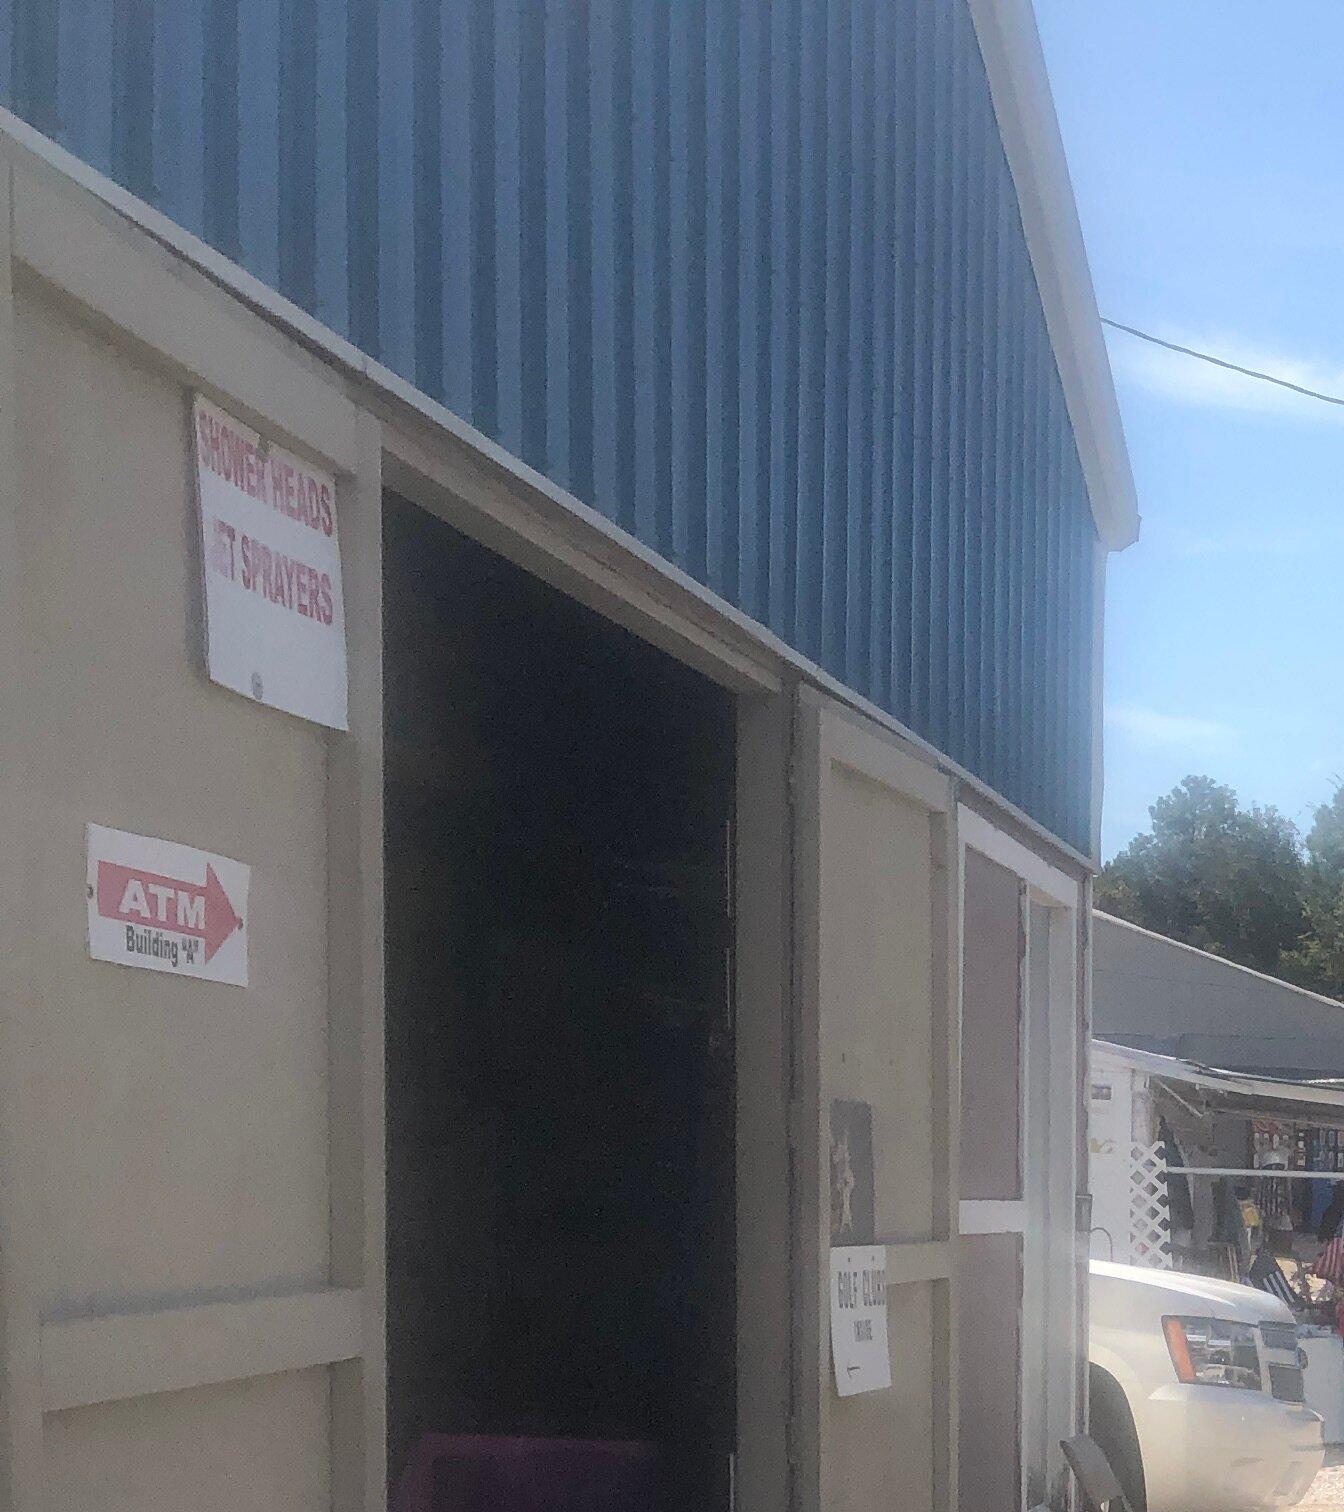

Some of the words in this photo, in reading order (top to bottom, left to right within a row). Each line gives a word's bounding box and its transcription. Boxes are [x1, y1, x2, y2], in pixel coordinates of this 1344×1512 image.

[271, 457, 333, 538] HEADS
[241, 534, 333, 626] SPRAYERS
[119, 878, 206, 930] ATM
[126, 925, 179, 967] Building
